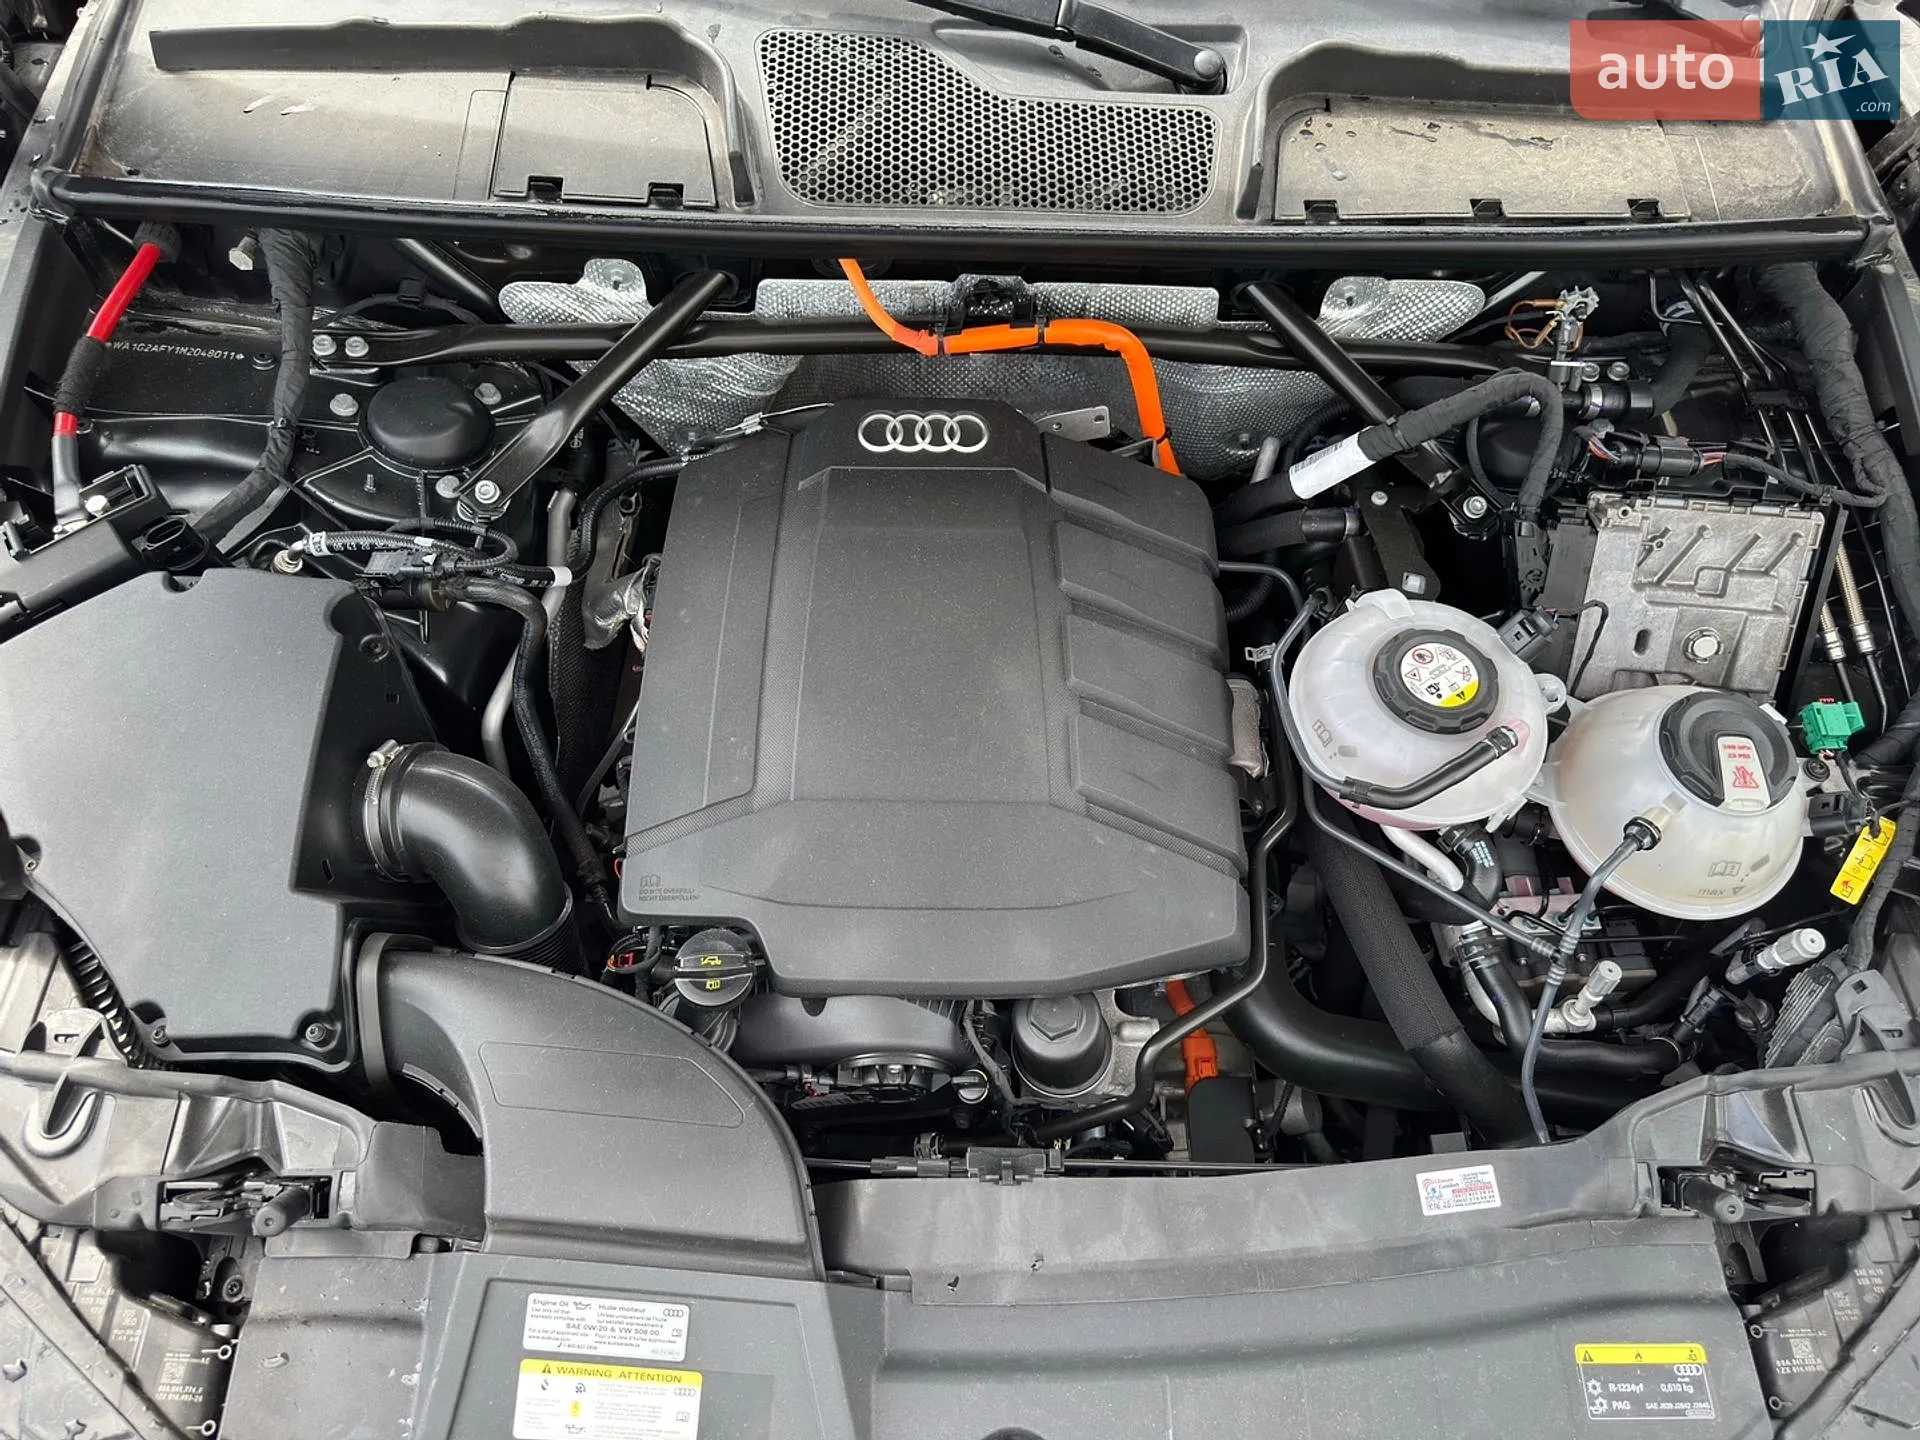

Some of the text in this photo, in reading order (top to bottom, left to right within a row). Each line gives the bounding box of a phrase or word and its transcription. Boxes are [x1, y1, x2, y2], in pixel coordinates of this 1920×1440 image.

[532, 1298, 557, 1308] Engine
[598, 1303, 646, 1314] Huile moteur
[566, 1322, 582, 1330] SAE
[583, 1324, 608, 1332] 0W-20
[556, 1366, 683, 1384] WARNING ATTENTION
[1608, 1382, 1644, 1394] R-1234yf
[1683, 1383, 1694, 1394] kg
[1611, 1400, 1631, 1410] PAG
